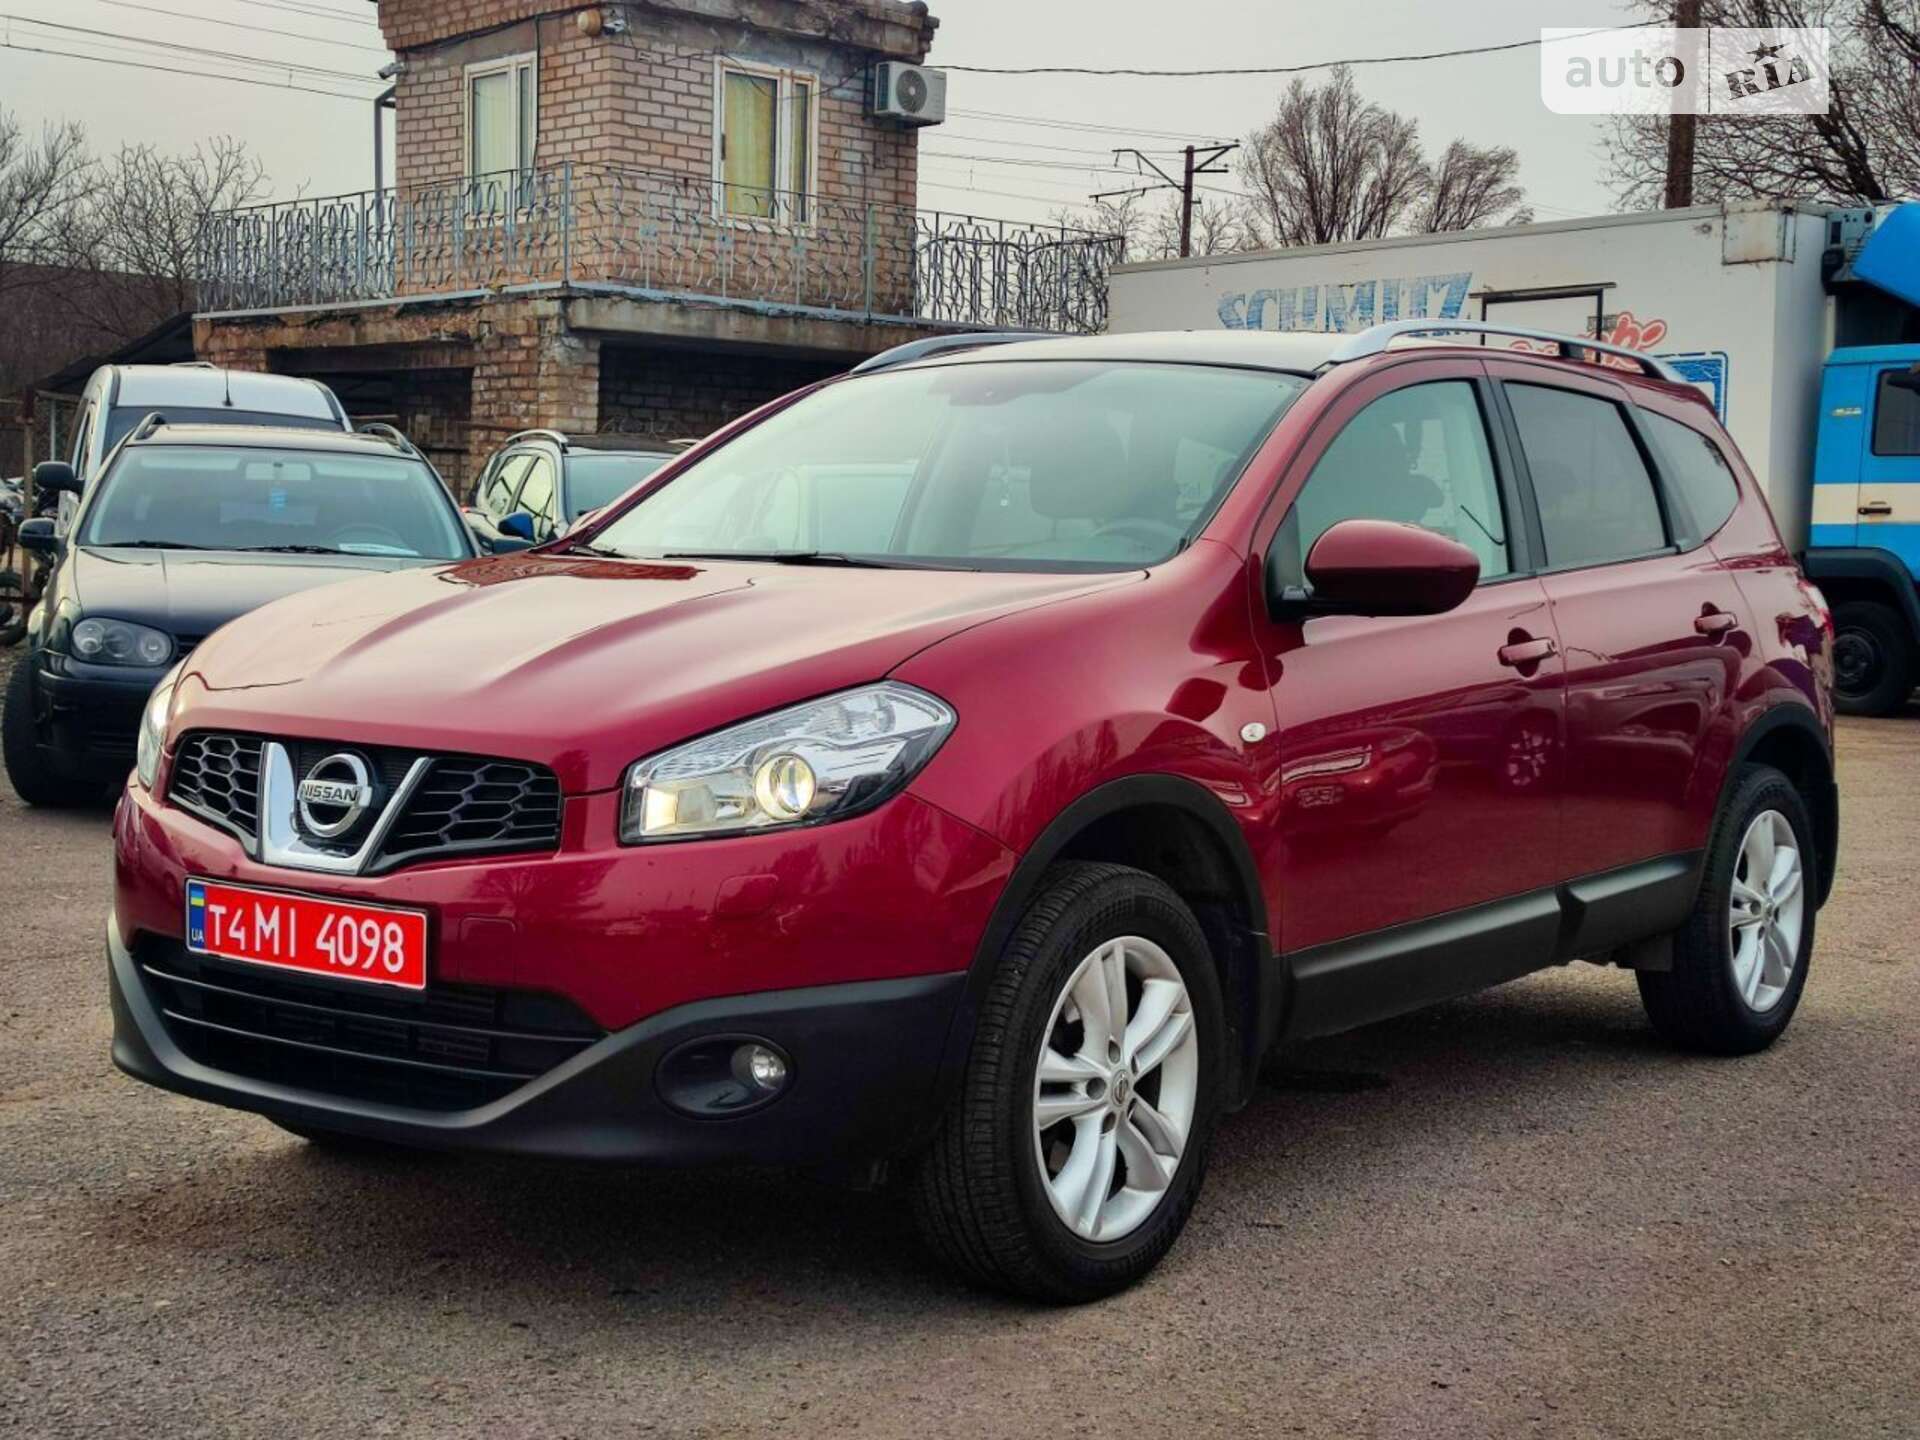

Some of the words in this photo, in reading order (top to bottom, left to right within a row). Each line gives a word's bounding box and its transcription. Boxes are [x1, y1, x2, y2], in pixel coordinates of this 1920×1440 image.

[300, 783, 359, 802] NISSAN
[191, 928, 205, 943] UA
[208, 902, 296, 957] T4MI
[316, 913, 405, 973] 4098
